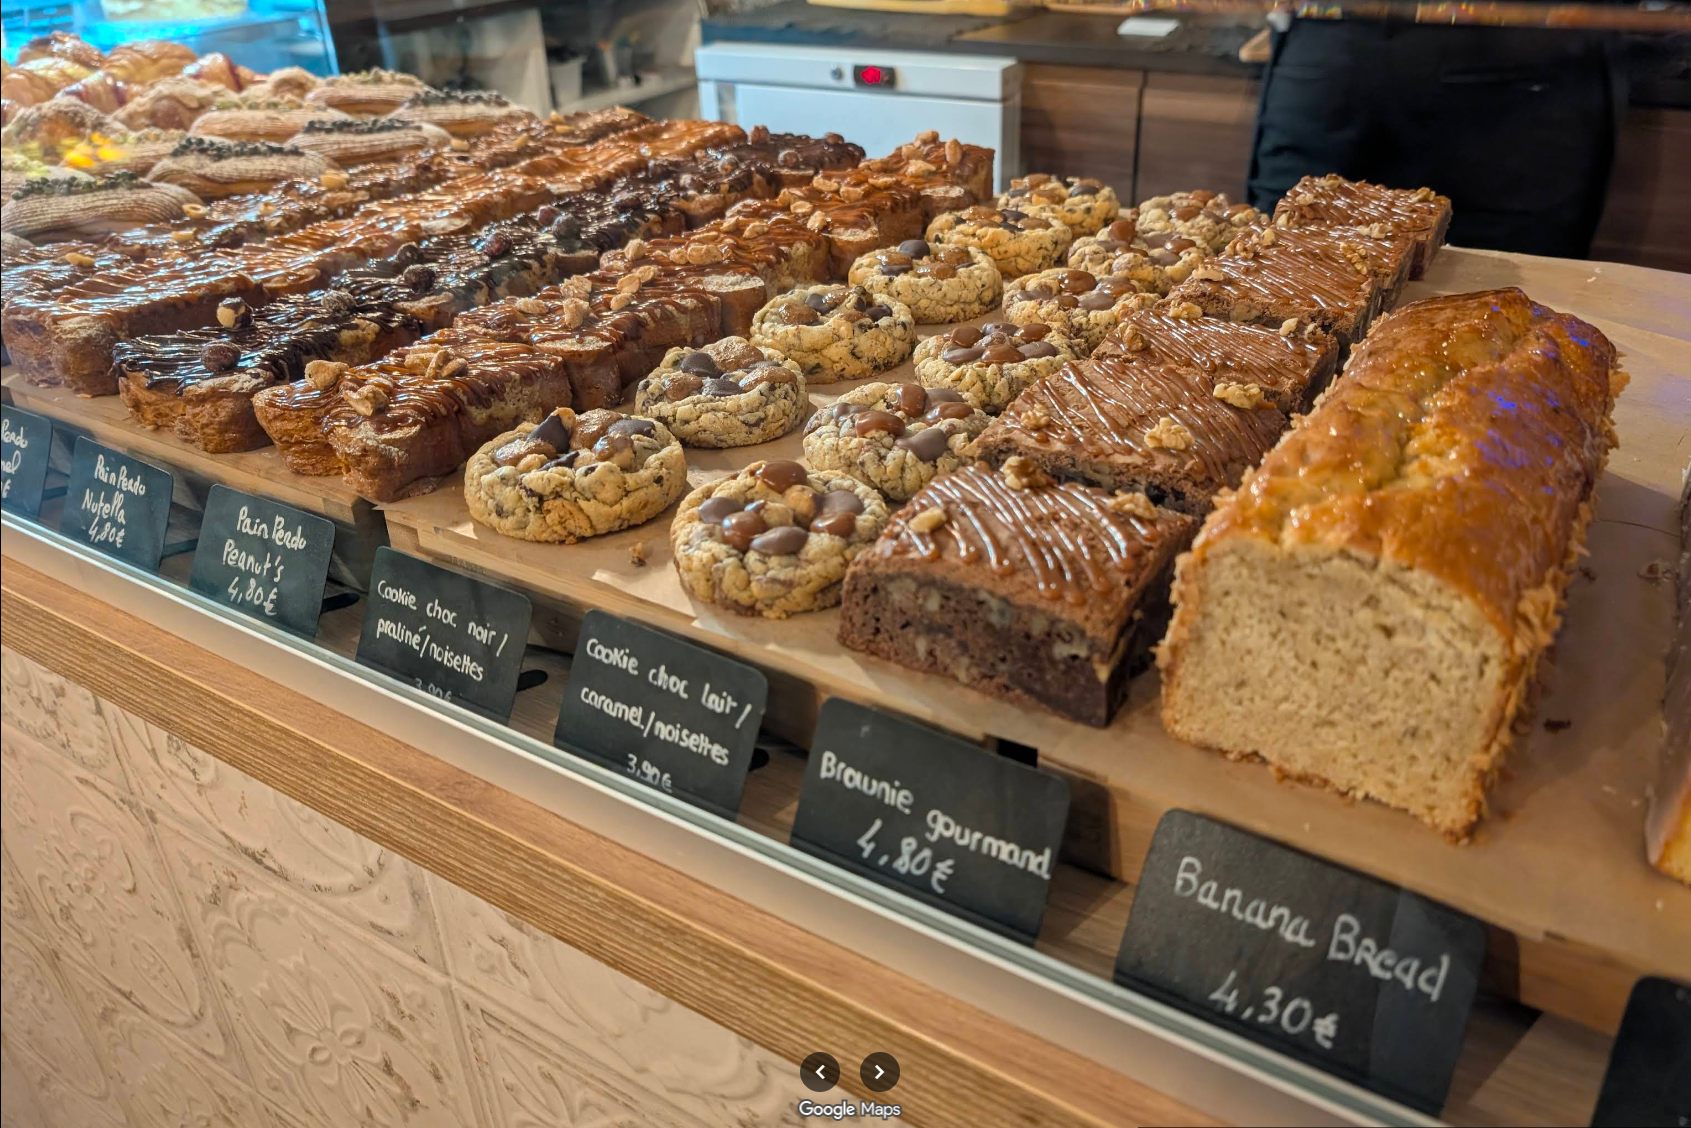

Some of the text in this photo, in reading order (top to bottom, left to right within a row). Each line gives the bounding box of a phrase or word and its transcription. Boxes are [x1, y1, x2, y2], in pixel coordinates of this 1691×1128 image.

[94, 453, 117, 486] Pain
[81, 488, 126, 525] Nutella
[88, 516, 125, 548] 4,80€
[236, 505, 269, 539] Pain
[222, 538, 284, 583] Peanut's
[227, 576, 278, 616] 4,80€
[377, 580, 417, 610] Cookie
[426, 598, 457, 628] choc
[467, 621, 497, 646] noir
[586, 638, 639, 675] Cookie
[648, 664, 689, 699] choc
[701, 682, 738, 714] lait
[820, 750, 1052, 880] Brownie gourmand
[856, 818, 955, 894] 4,80€
[1174, 855, 1316, 947] Banana
[1209, 969, 1340, 1050] 4,30€
